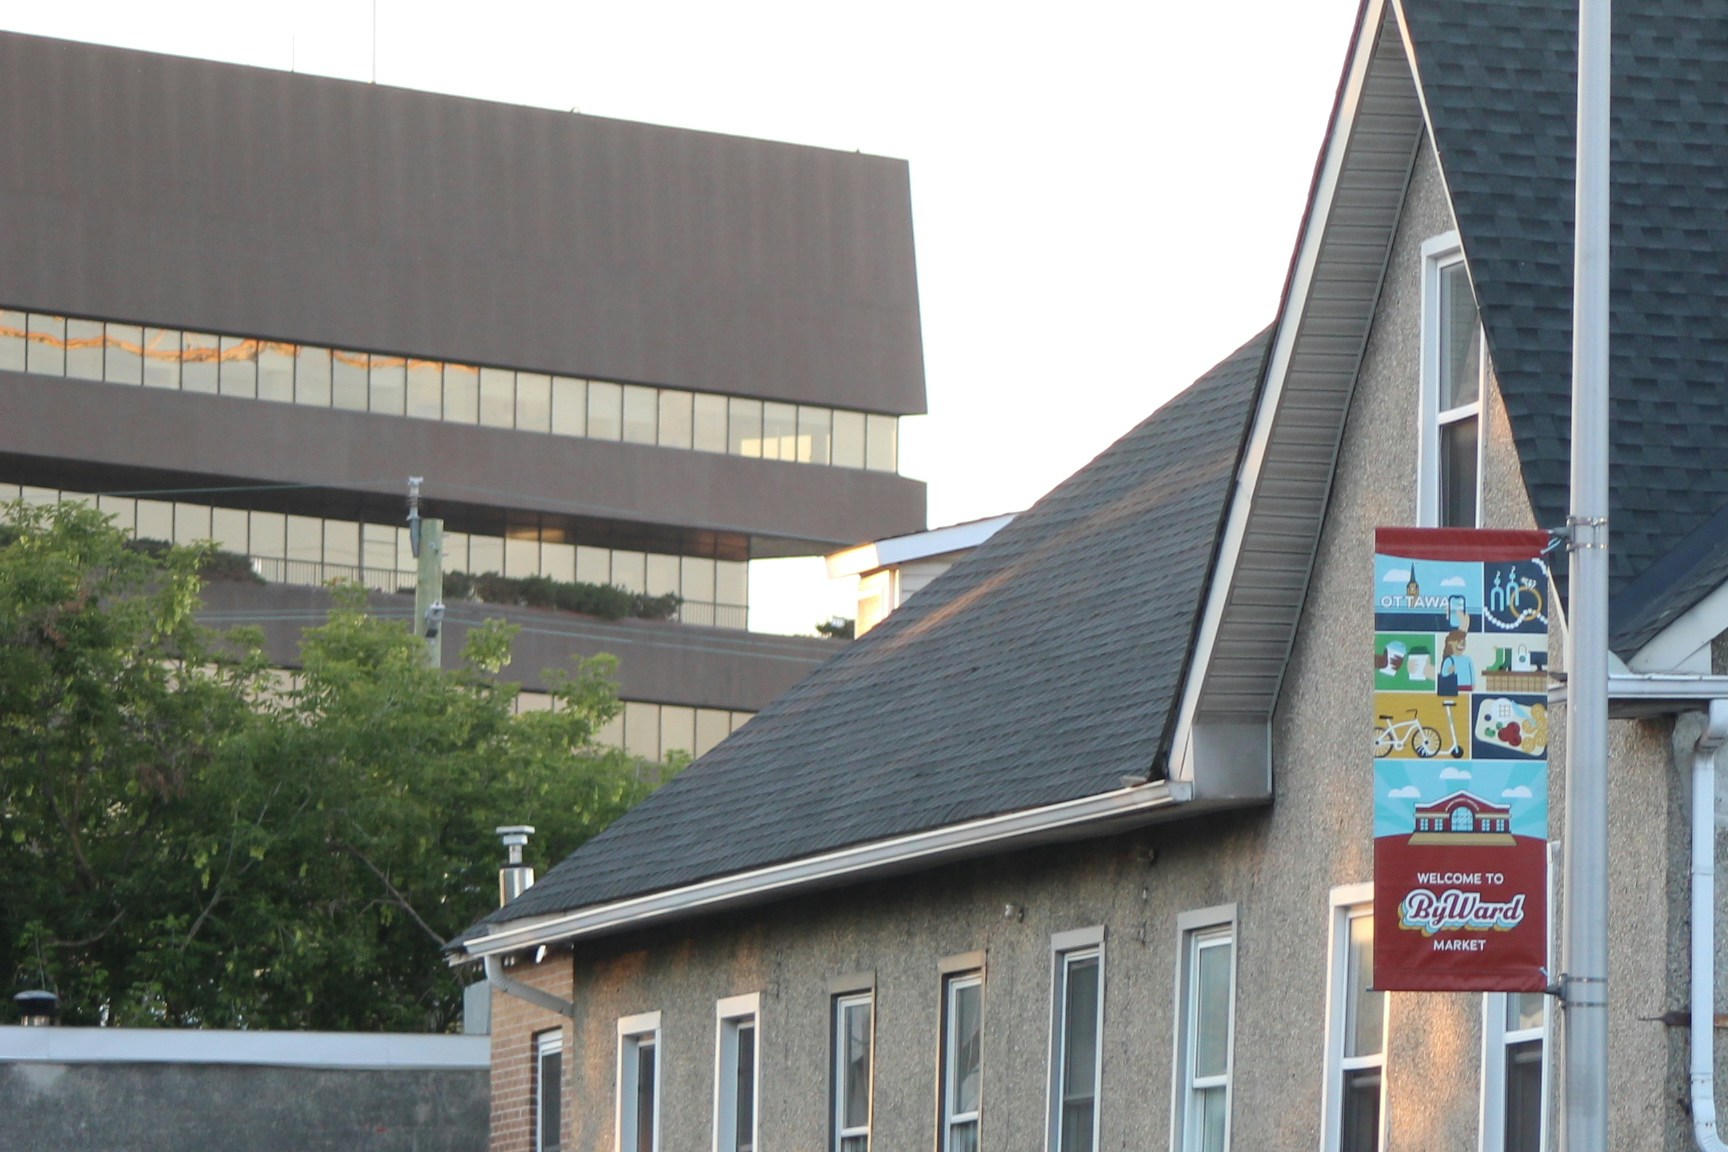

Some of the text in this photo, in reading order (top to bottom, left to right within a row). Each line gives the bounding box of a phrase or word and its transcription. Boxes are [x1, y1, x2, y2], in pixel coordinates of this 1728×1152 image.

[1380, 595, 1449, 609] OTTAWA
[1417, 871, 1504, 885] WELCOME TO
[1404, 888, 1525, 930] ByWard
[1433, 939, 1487, 951] MARKET
